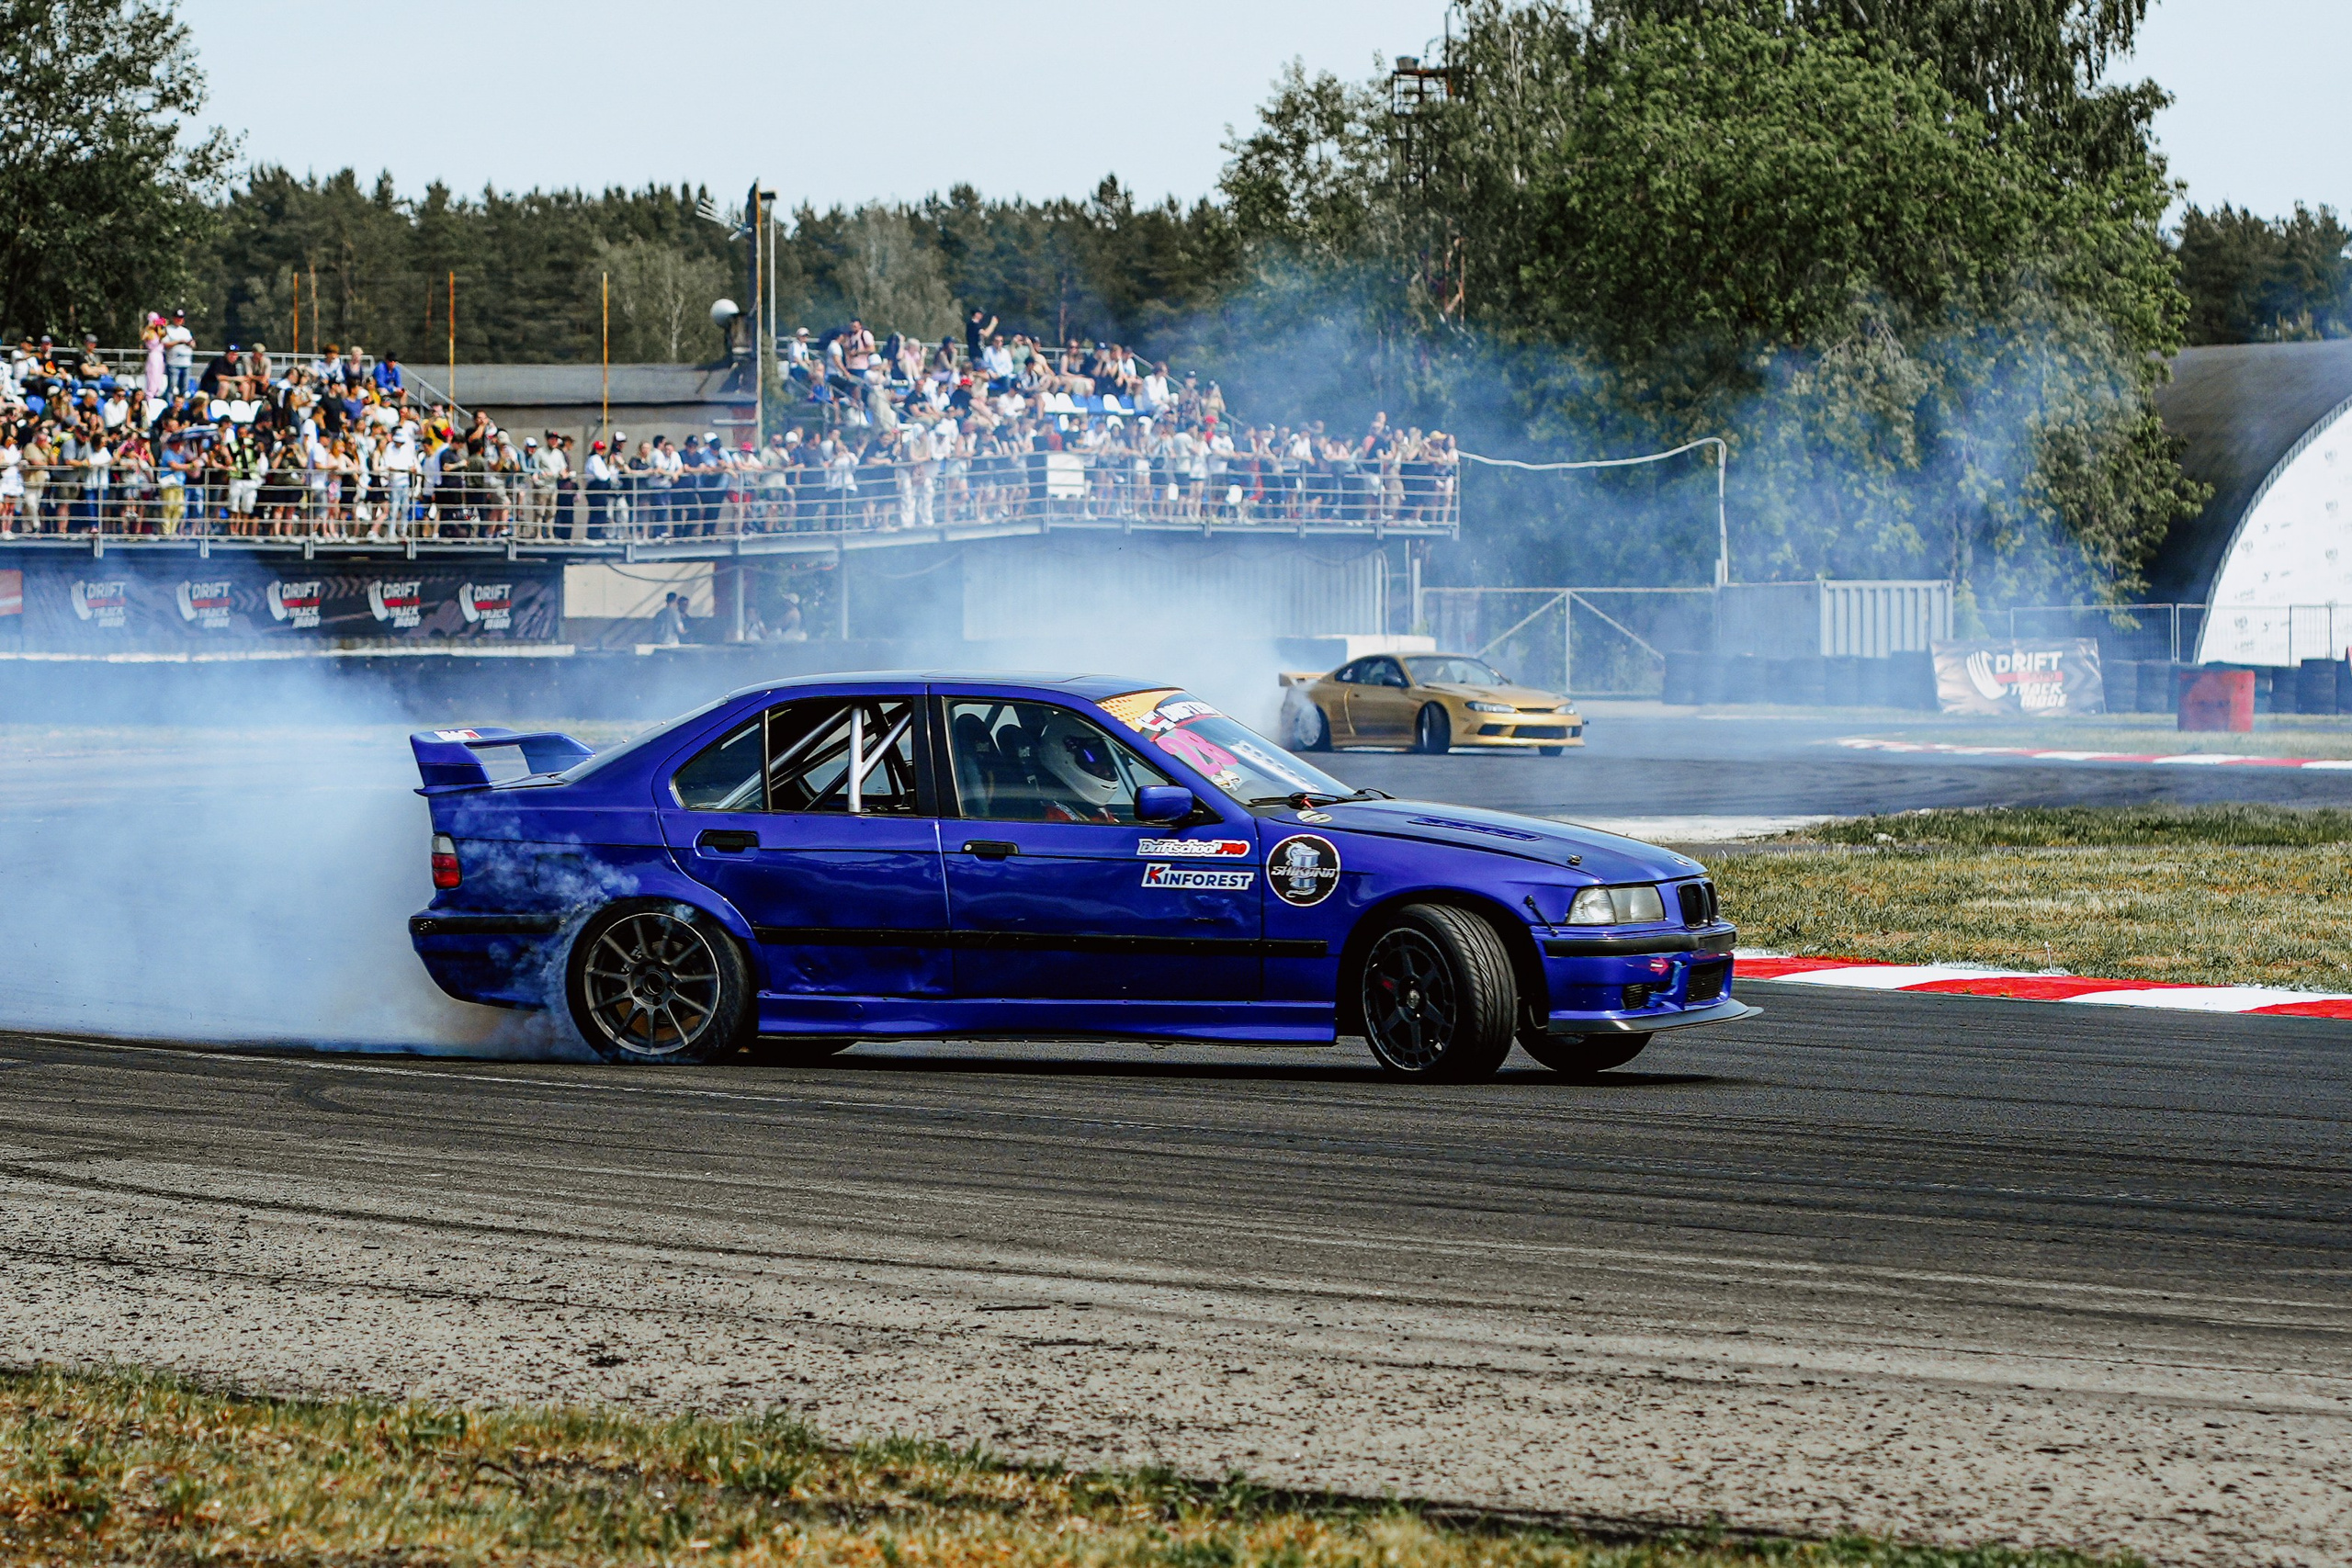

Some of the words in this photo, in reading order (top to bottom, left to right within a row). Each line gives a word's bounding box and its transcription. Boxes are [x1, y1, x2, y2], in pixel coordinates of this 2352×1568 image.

[86, 581, 126, 599] DRIFT
[191, 581, 231, 599] DRIFT
[282, 581, 321, 598] DRIFT
[383, 581, 421, 598] DRIFT
[474, 584, 512, 602] DRIFT
[1996, 651, 2064, 673] DRIFT
[2010, 682, 2063, 696] TRACK
[1155, 728, 1238, 777] 28
[1146, 866, 1250, 887] KINFOREST
